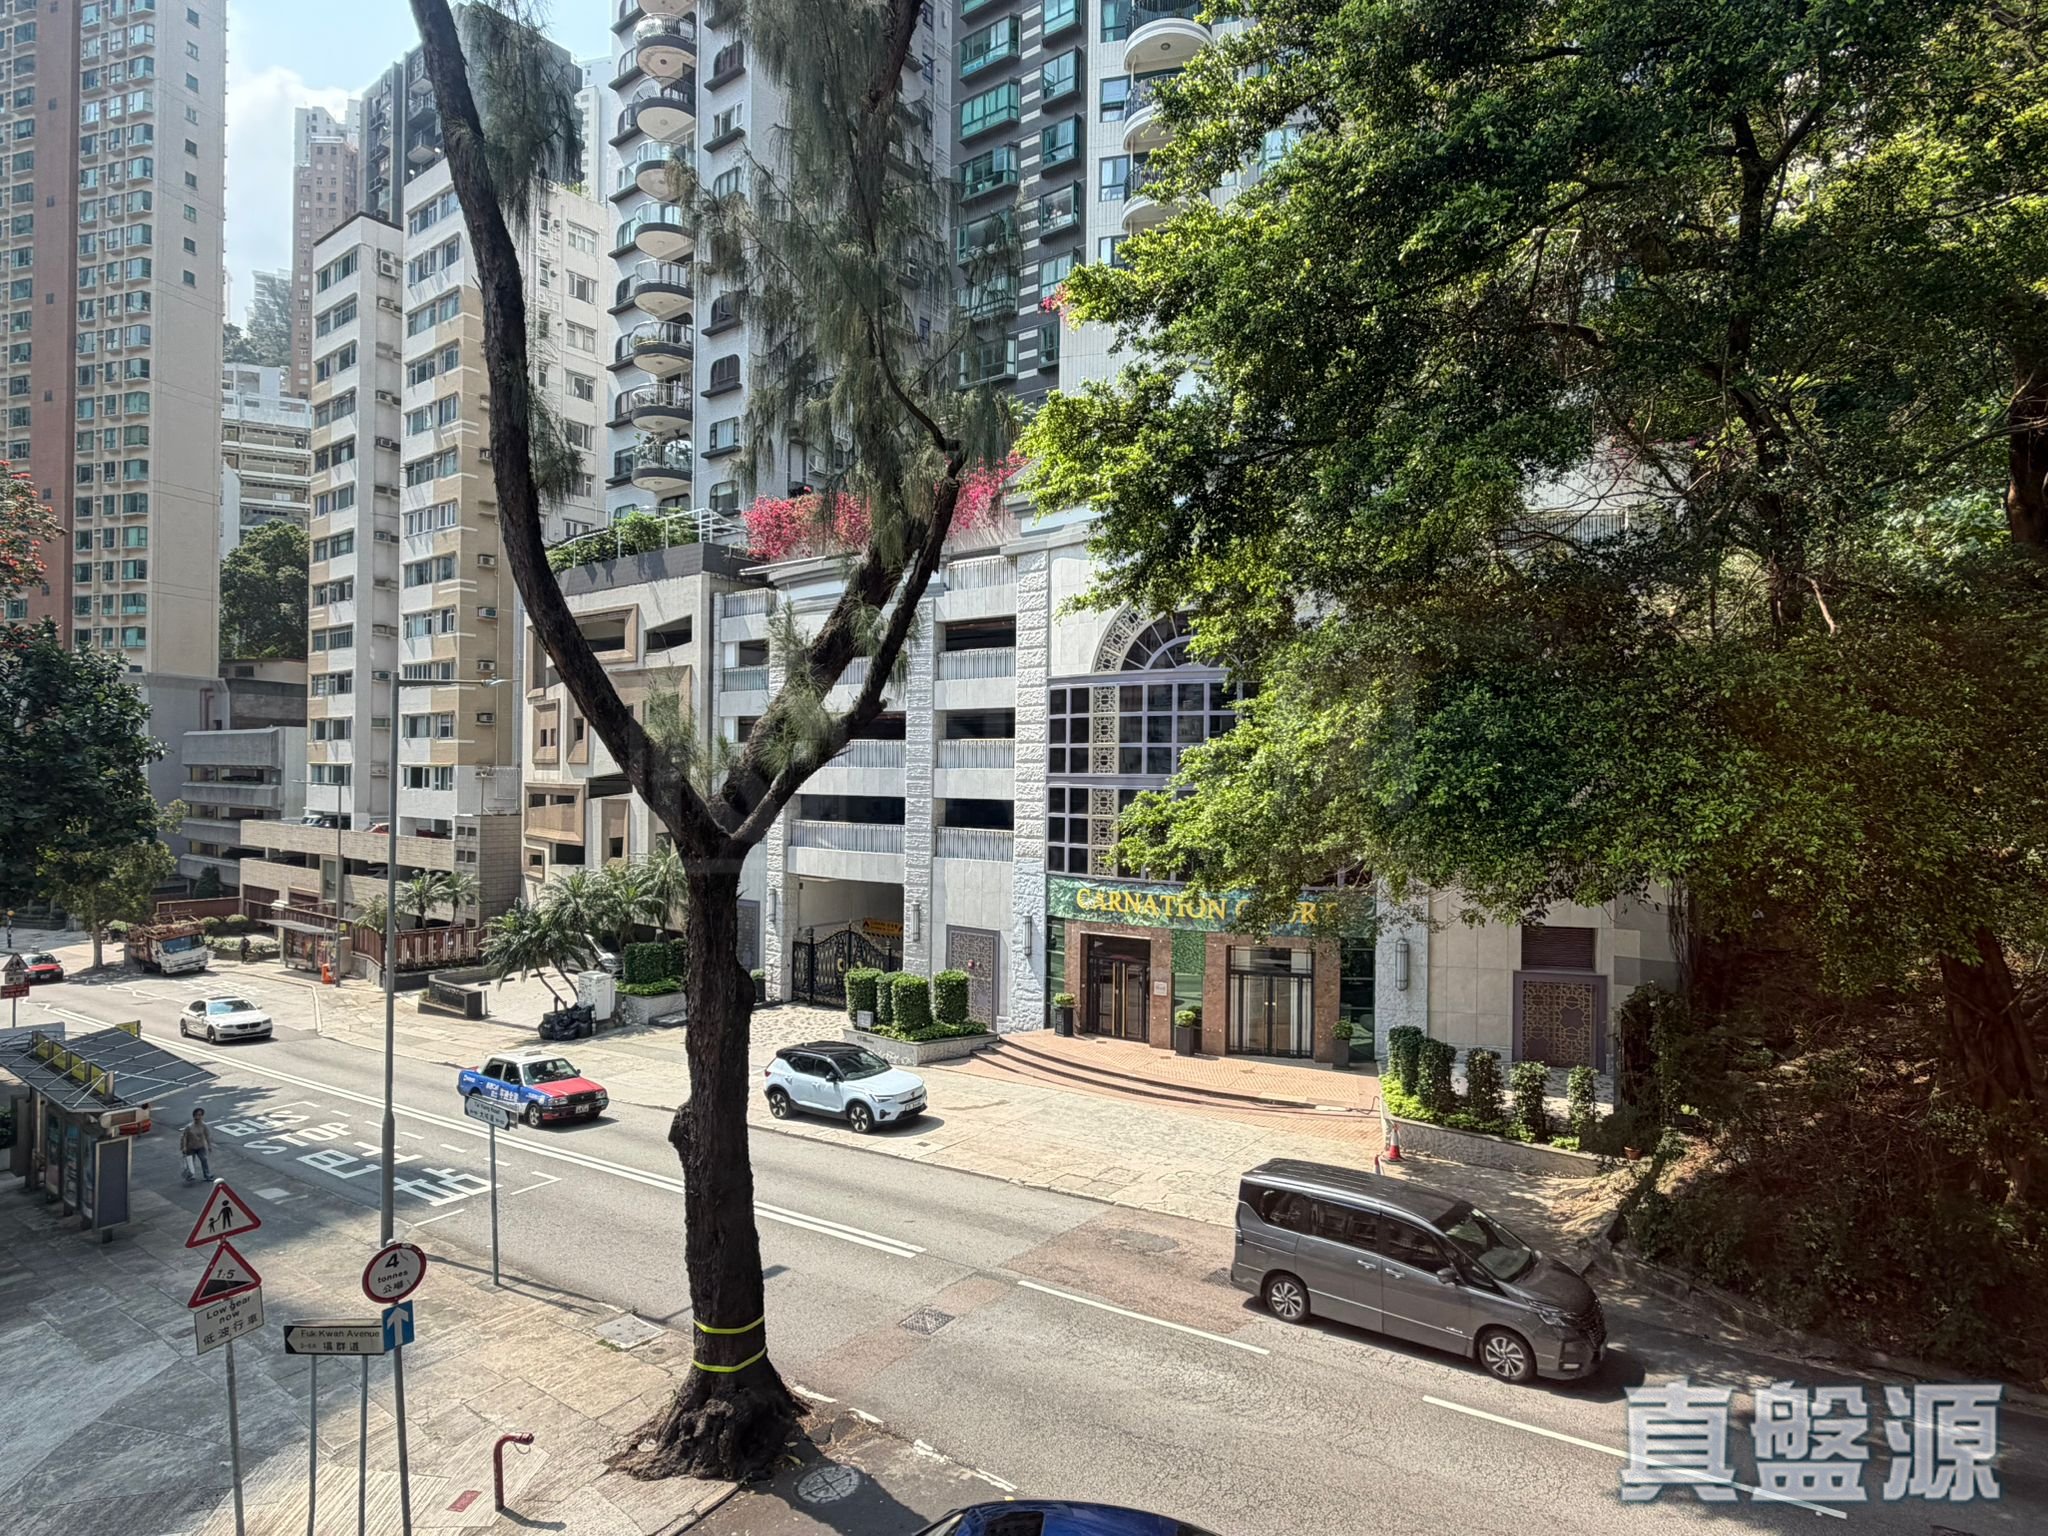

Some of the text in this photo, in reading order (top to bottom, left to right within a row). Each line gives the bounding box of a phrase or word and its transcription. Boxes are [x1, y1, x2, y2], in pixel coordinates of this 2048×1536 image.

[1076, 888, 1227, 920] CARNATION
[214, 1110, 311, 1137] BUS
[244, 1122, 352, 1155] STOP
[385, 1253, 400, 1269] 4
[216, 1269, 236, 1279] 1:5
[377, 1270, 408, 1283] tonnes
[206, 1296, 251, 1320] Low gear
[219, 1310, 240, 1324] now
[301, 1330, 380, 1338] Fuk Kwan Avenue
